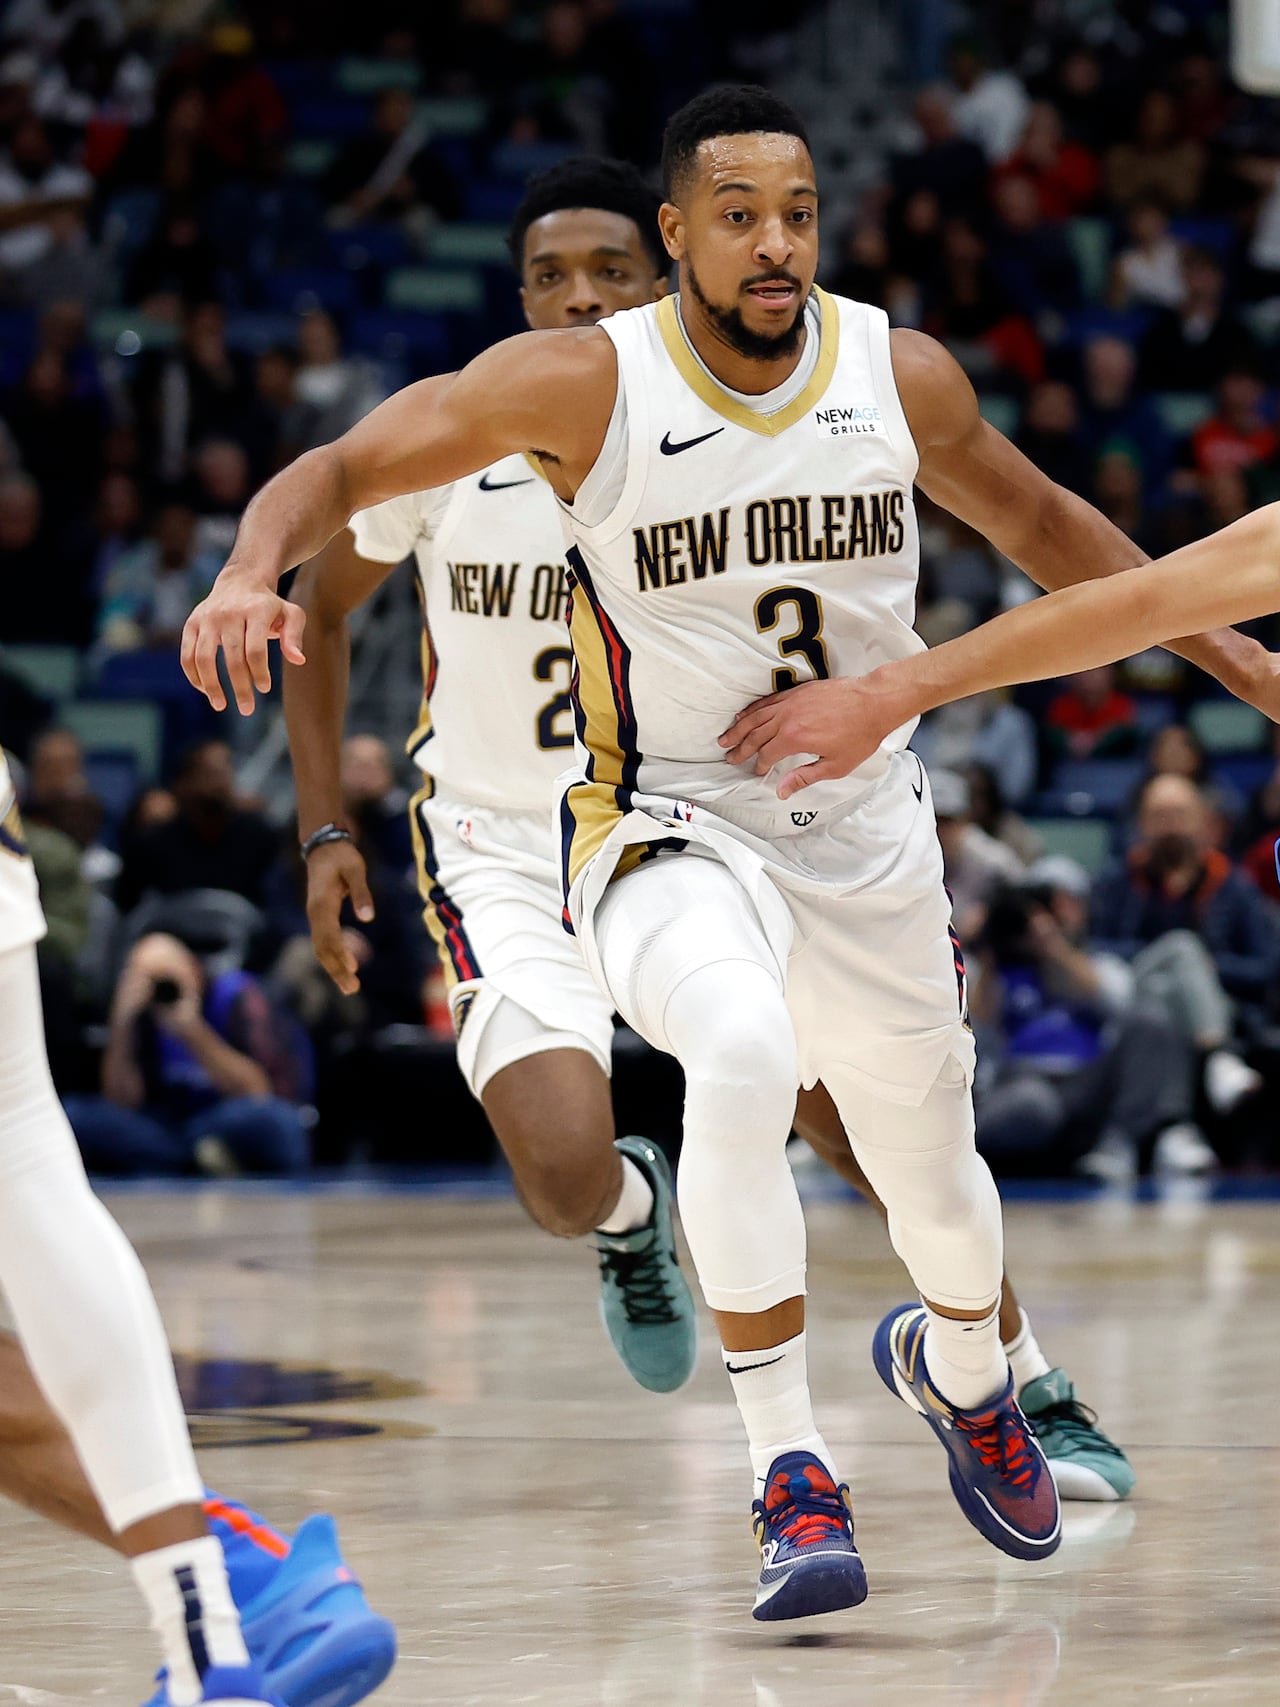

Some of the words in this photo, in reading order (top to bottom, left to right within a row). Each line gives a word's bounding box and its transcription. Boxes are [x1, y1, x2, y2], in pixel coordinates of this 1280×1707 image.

[830, 424, 876, 435] GRILLS
[632, 506, 731, 592] NEW
[744, 489, 905, 567] ORLEANS
[447, 561, 521, 618] NEW
[753, 585, 832, 694] 3
